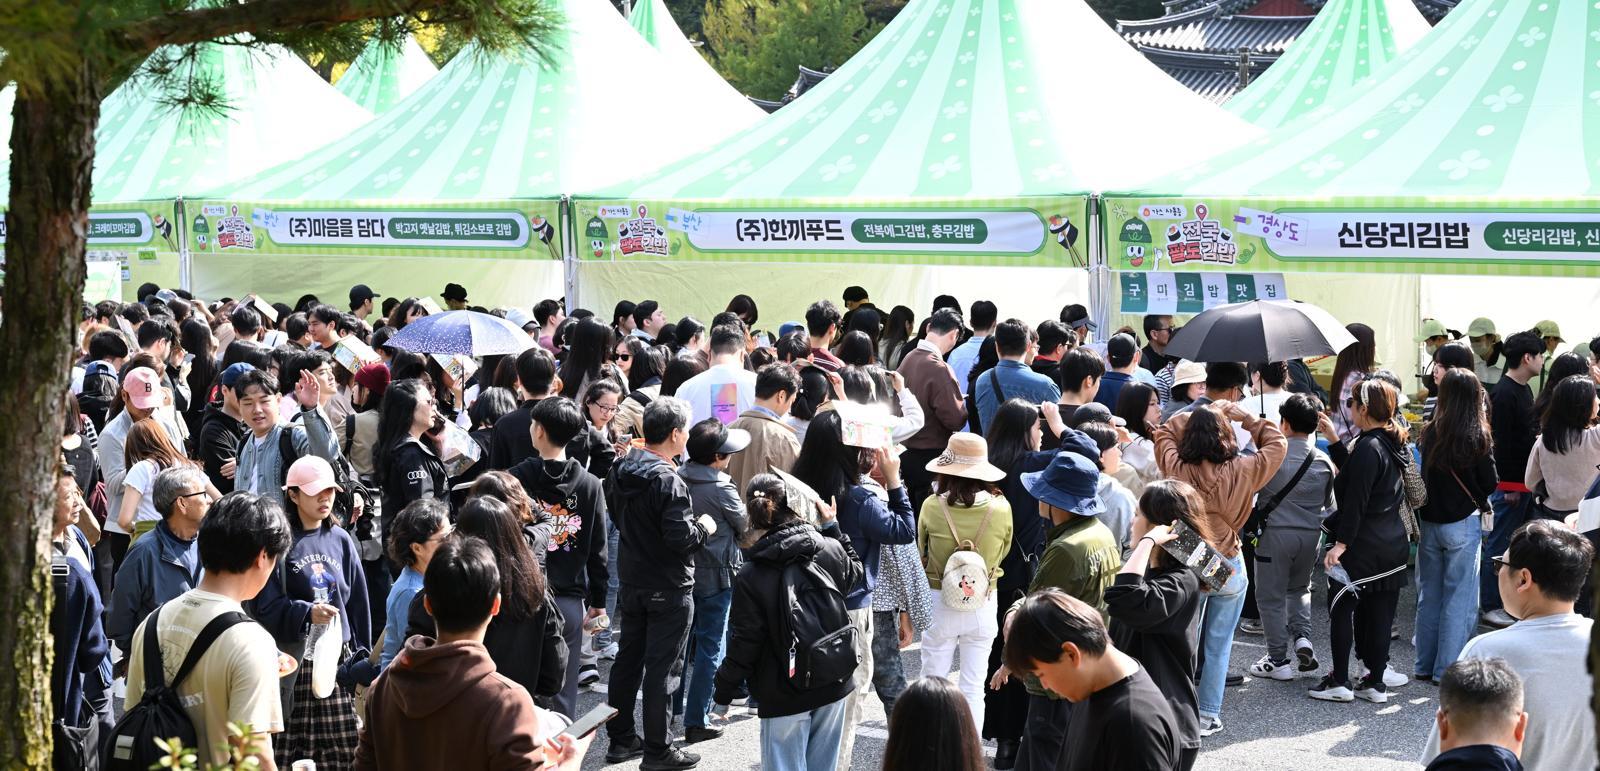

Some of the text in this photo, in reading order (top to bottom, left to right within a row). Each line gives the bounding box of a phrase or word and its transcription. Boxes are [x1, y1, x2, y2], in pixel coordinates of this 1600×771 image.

[289, 217, 385, 238] (주)마음을 담다
[395, 222, 418, 235] 박고지
[454, 223, 495, 236] 튀김소보로
[495, 223, 512, 236] 김밥
[683, 214, 702, 232] 부산
[736, 218, 844, 242] (주)한끼푸드
[863, 224, 975, 240] 전복에그김밥, 충무김밥
[1182, 220, 1220, 242] 전국
[1257, 213, 1299, 242] 경상도
[1338, 221, 1470, 249] 신당리김밥
[1502, 227, 1582, 247] 신당리김밥,
[1167, 241, 1236, 264] 팔도김밥
[144, 382, 152, 393] B
[292, 553, 341, 574] SKATEBOARD
